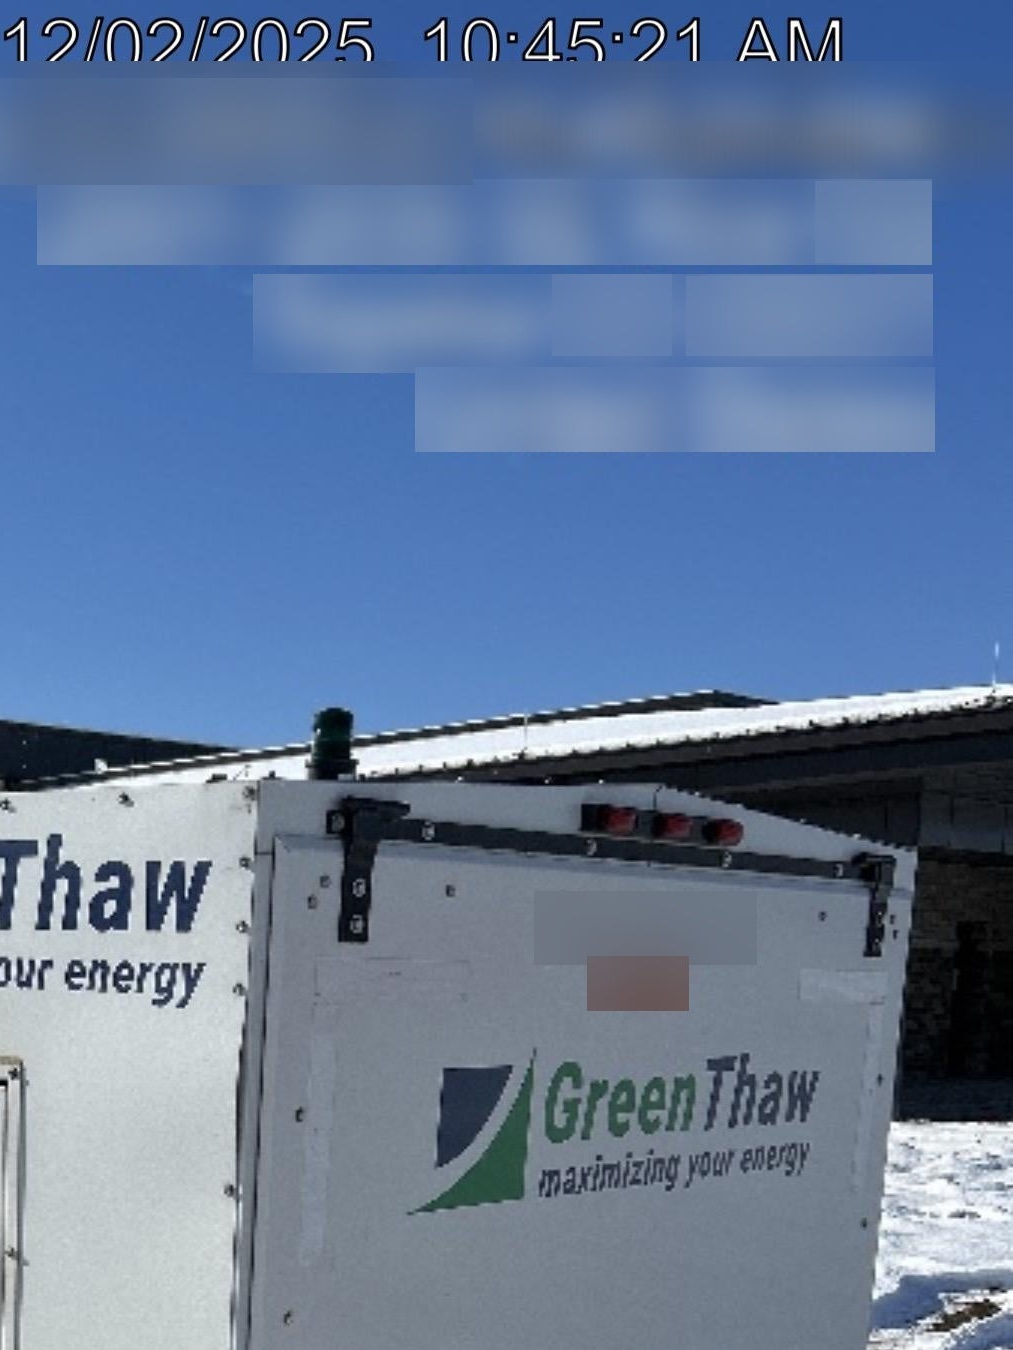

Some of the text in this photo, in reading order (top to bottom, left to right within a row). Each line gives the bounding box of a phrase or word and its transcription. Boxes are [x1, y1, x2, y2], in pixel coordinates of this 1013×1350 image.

[64, 960, 207, 1008] energy
[538, 1142, 811, 1198] maximizing your energy
